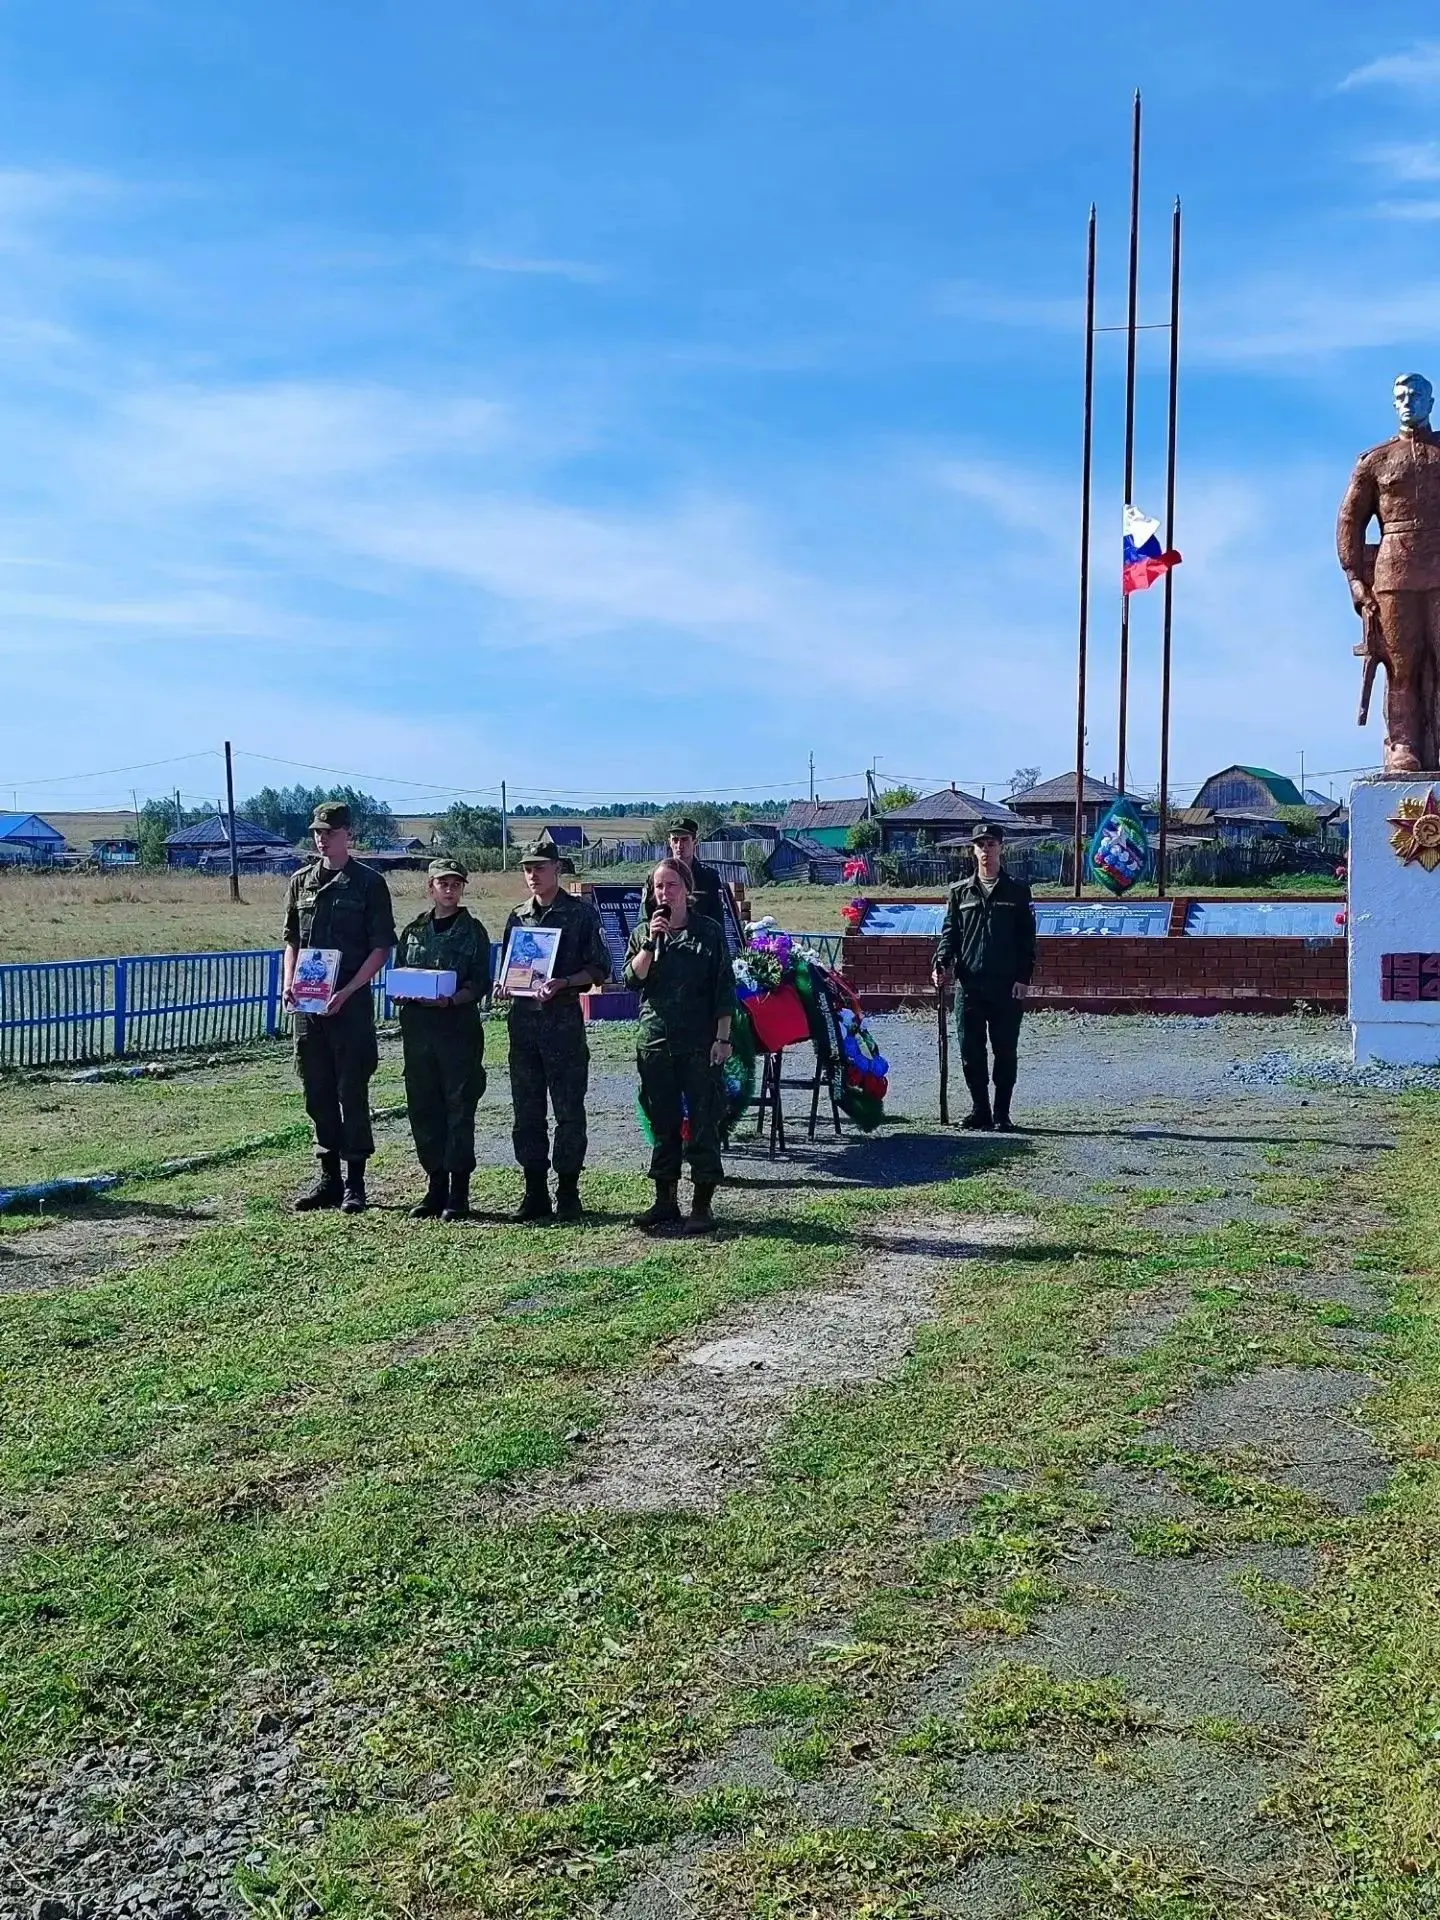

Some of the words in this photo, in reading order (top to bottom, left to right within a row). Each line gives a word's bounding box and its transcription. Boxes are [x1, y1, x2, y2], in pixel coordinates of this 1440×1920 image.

[622, 902, 640, 910] ВЕР
[1381, 953, 1440, 977] 194
[1381, 977, 1440, 1001] 194
